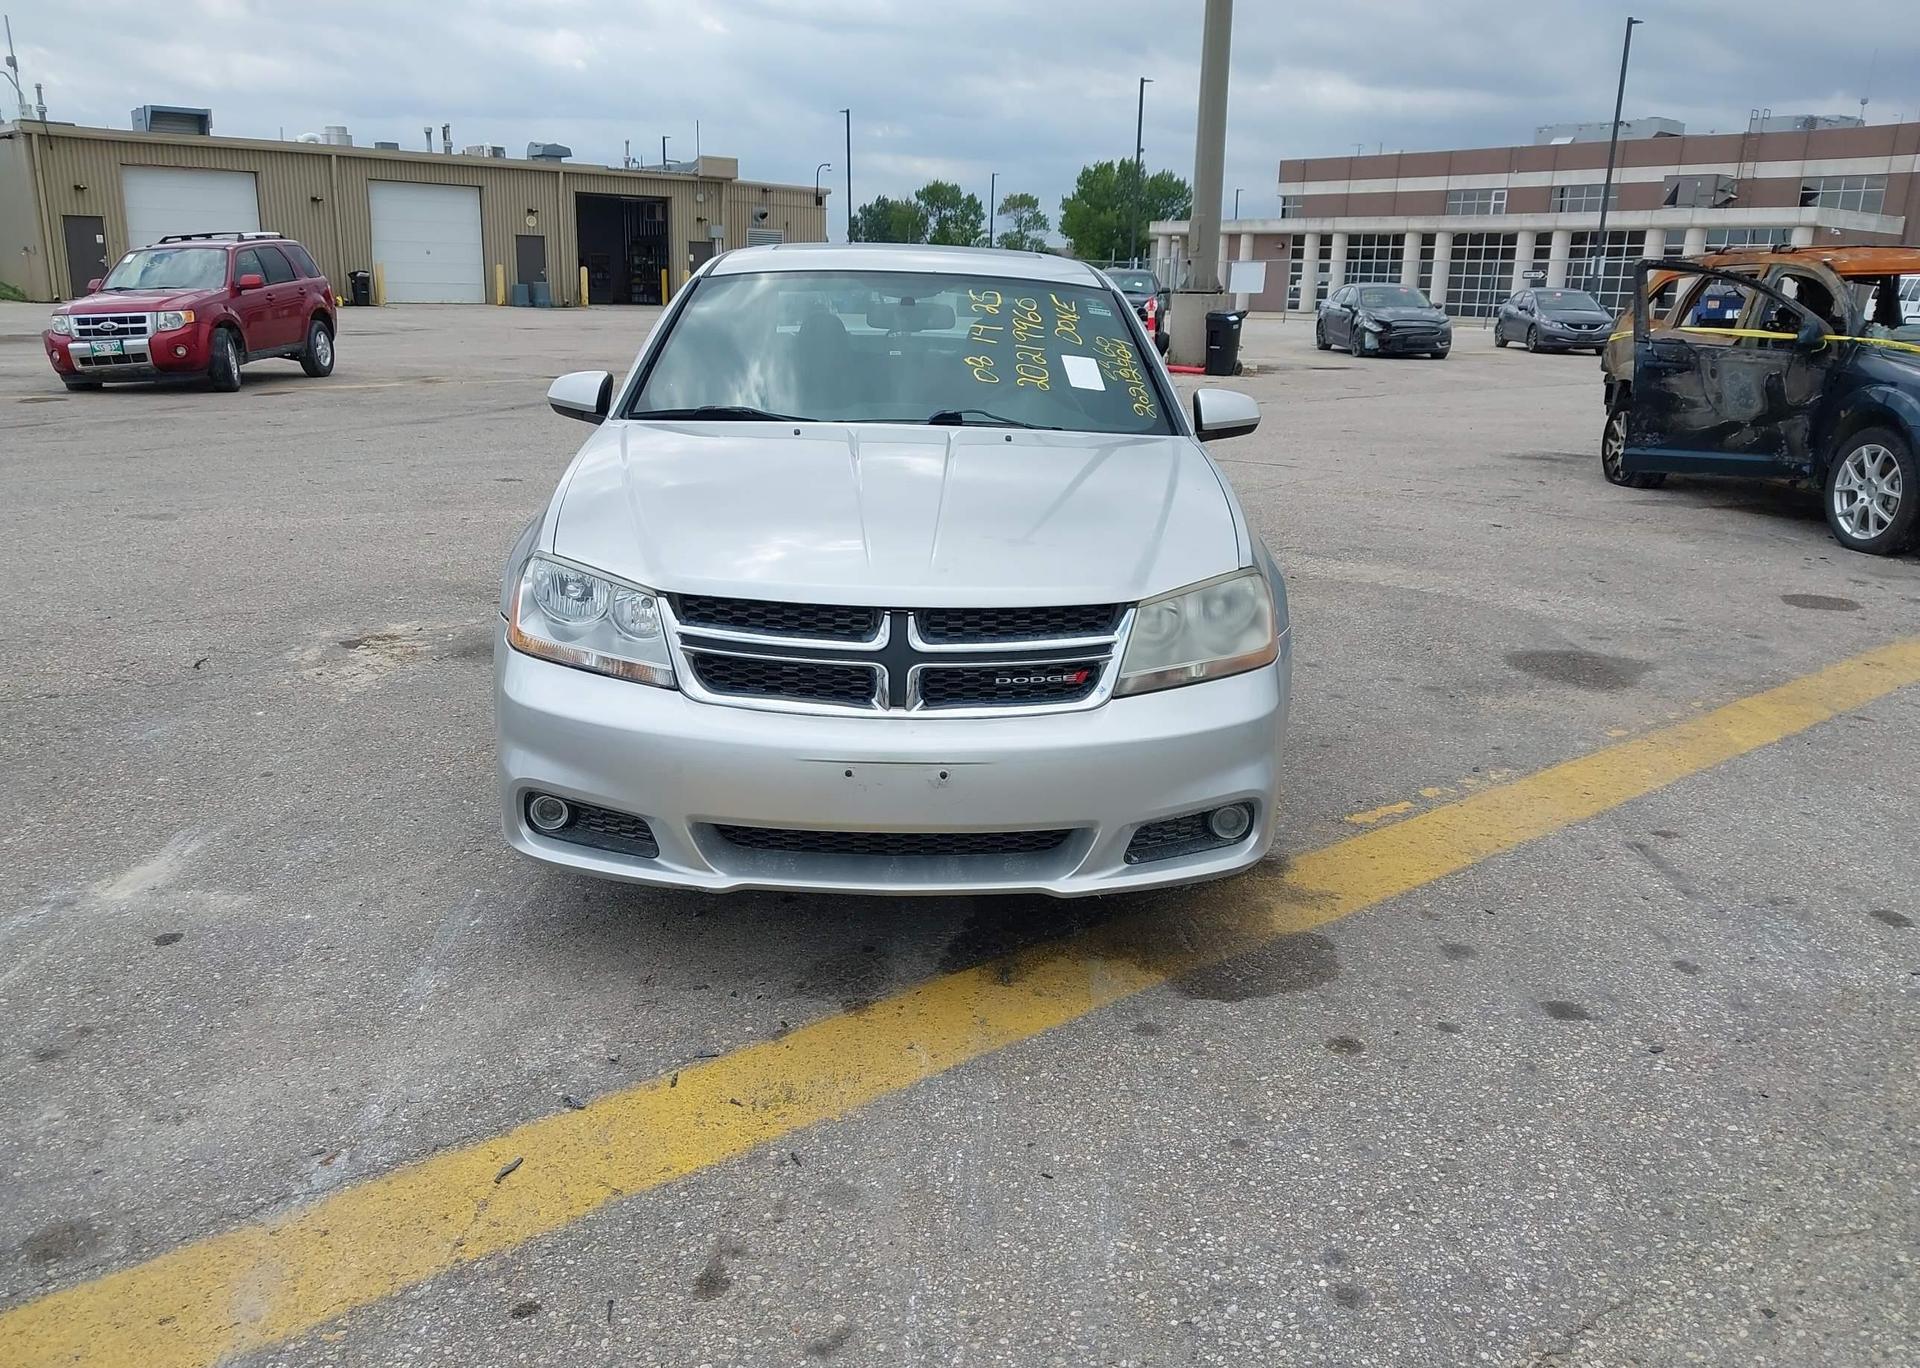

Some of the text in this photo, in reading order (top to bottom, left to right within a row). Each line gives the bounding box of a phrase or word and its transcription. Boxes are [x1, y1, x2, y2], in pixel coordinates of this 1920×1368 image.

[964, 288, 1004, 384] 08 14 25
[1012, 297, 1050, 391] 20219960
[1049, 293, 1083, 346] DONE
[995, 674, 1077, 685] DODGE
